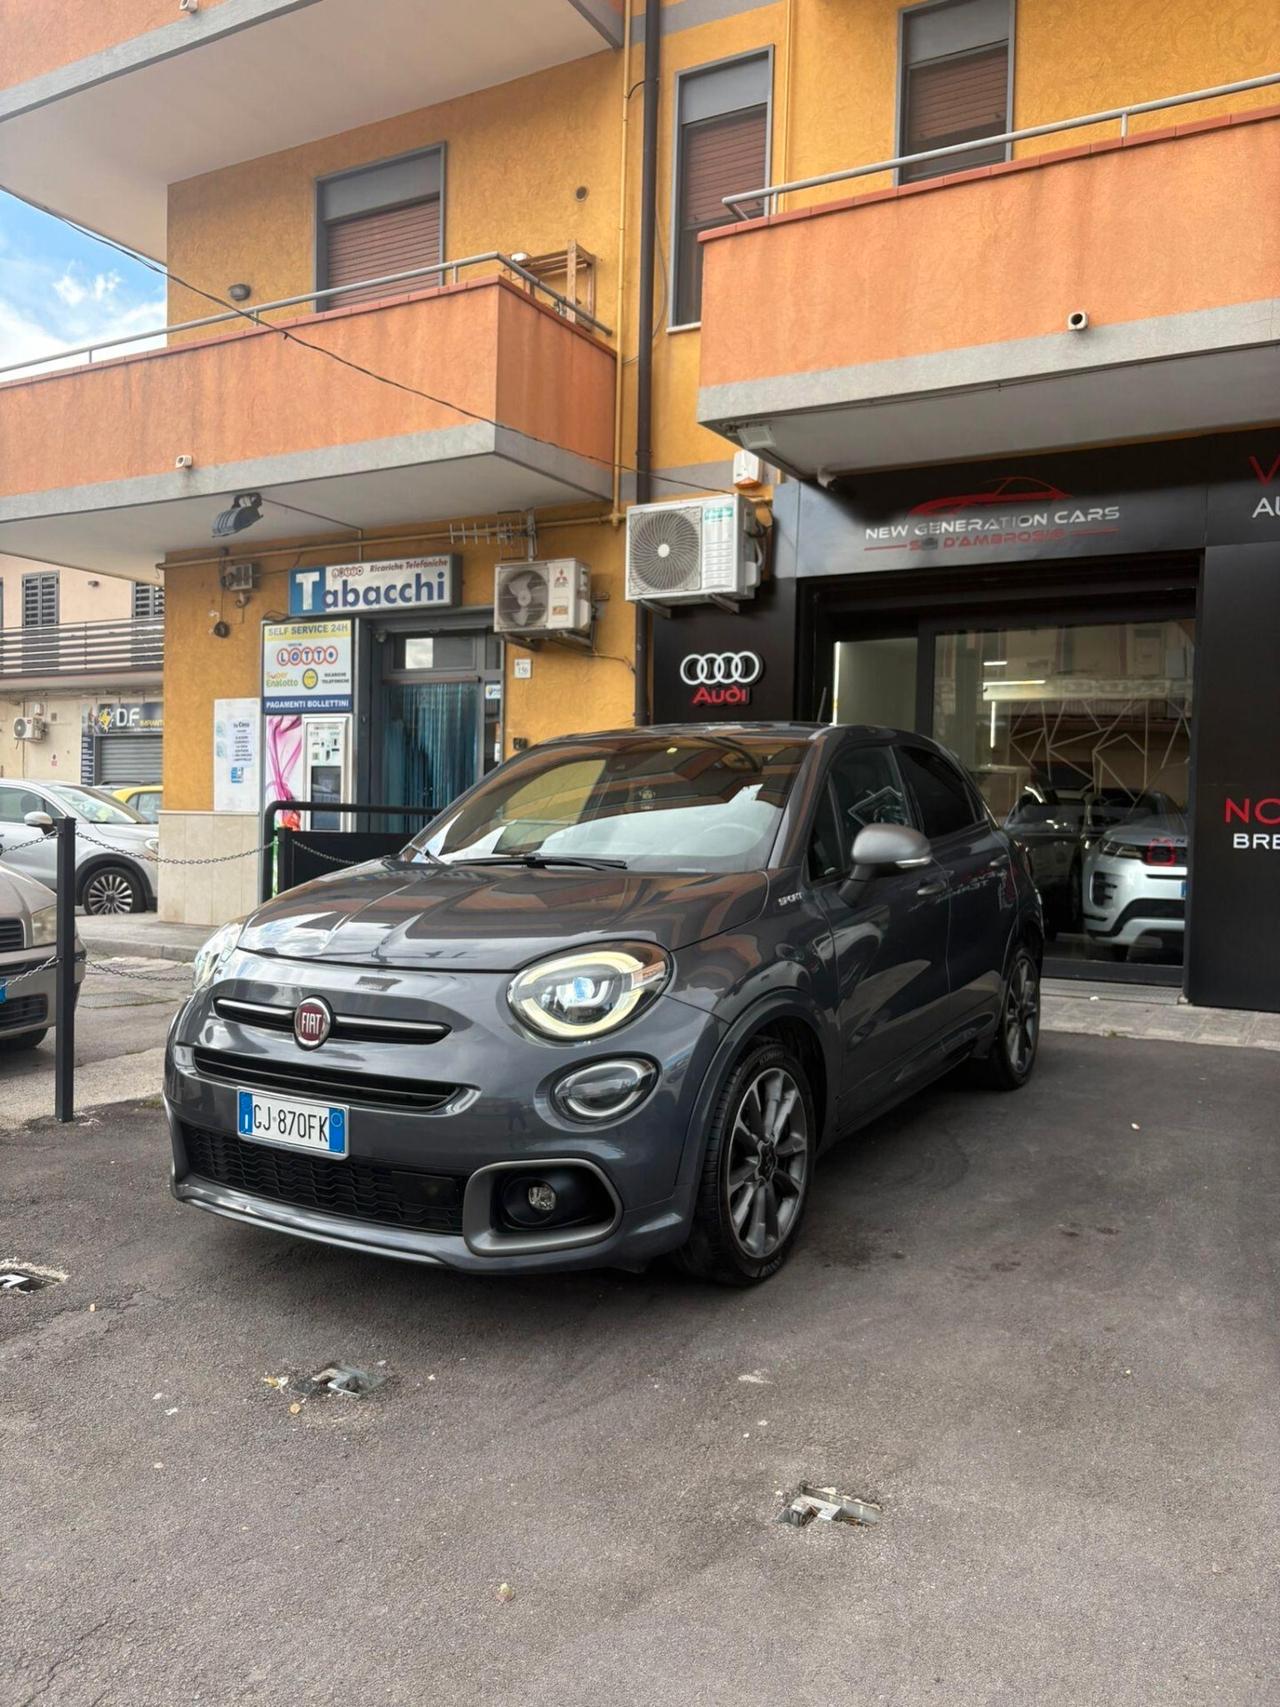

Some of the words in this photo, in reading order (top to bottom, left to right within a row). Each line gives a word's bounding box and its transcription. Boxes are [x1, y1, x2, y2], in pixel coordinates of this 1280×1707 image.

[866, 525, 909, 540] NEW
[914, 513, 1047, 536] GENERATION
[1054, 506, 1120, 524] CARS
[370, 561, 404, 572] Ricariche
[405, 558, 448, 570] Telefoniche
[296, 572, 445, 610] Tabacchi
[268, 627, 289, 636] SELF
[291, 624, 328, 634] SERVICE
[331, 623, 348, 632] 24H
[277, 646, 338, 666] LOTTO
[266, 701, 306, 709] PAGAMENTI
[307, 700, 349, 708] BOLLETTINI
[301, 1012, 323, 1034] FIAT
